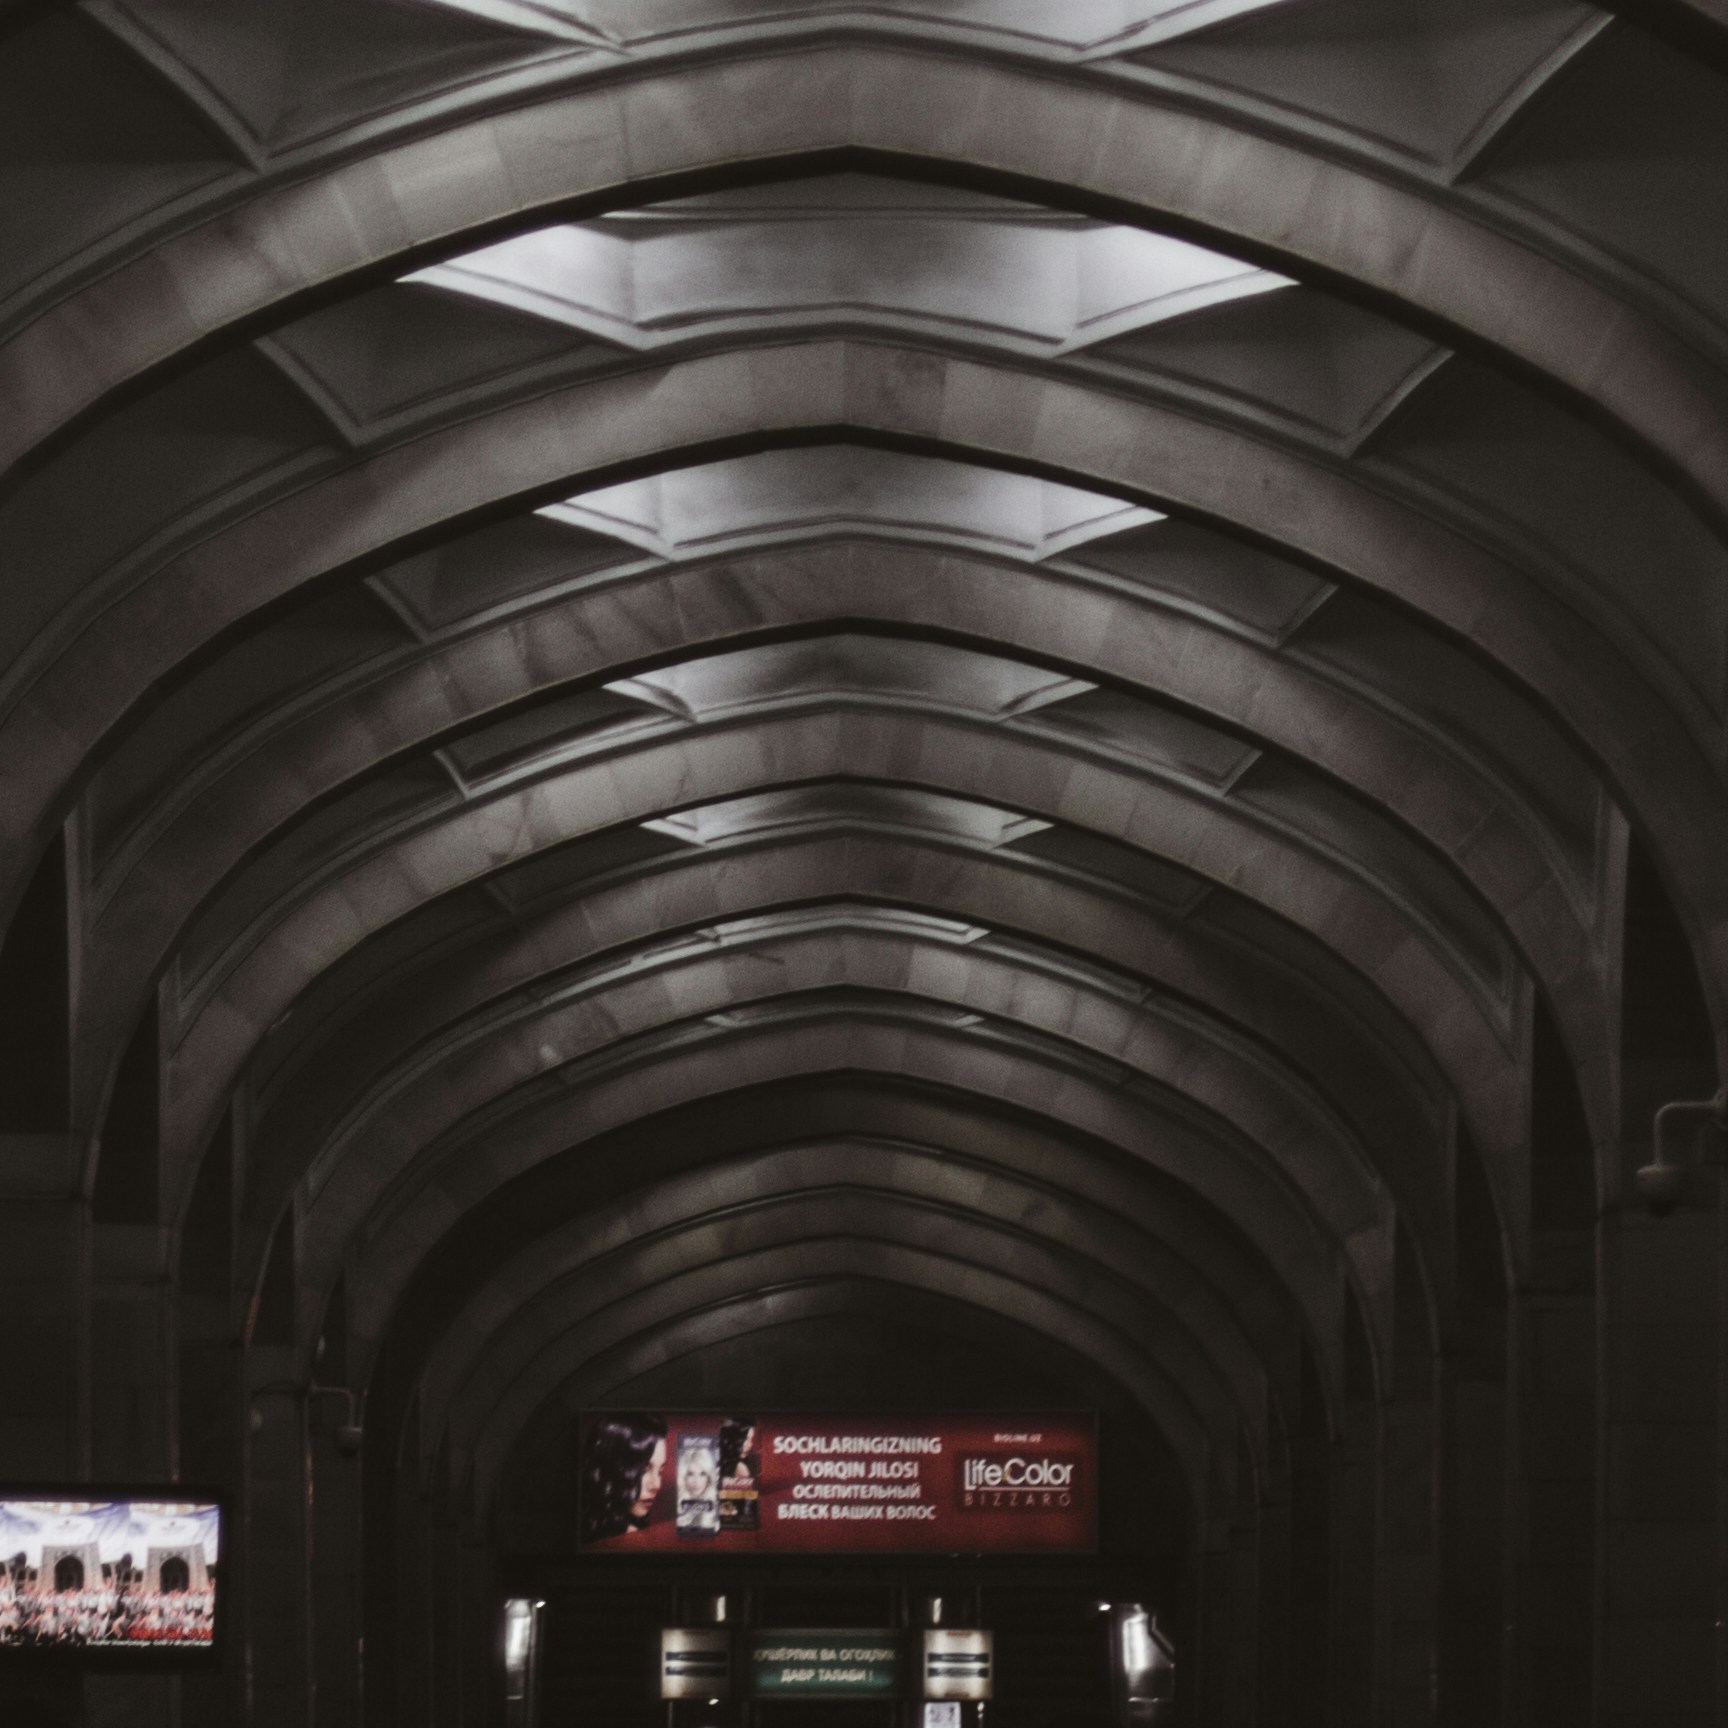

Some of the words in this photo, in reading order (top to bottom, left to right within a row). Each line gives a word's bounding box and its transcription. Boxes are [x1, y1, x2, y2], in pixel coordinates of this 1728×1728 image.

[773, 1436, 942, 1454] SOCHLARINGIZNING
[800, 1461, 865, 1479] YORQIN
[868, 1461, 918, 1478] JILOSI
[793, 1482, 921, 1499] ОСЛЕПИТЕЛЬНЫЙ
[964, 1492, 1071, 1507] BIZZARO
[778, 1504, 829, 1519] БЛЕСК
[831, 1505, 883, 1519] ВАШИХ
[886, 1505, 937, 1519] ВОЛОС
[820, 1648, 836, 1661] ВА
